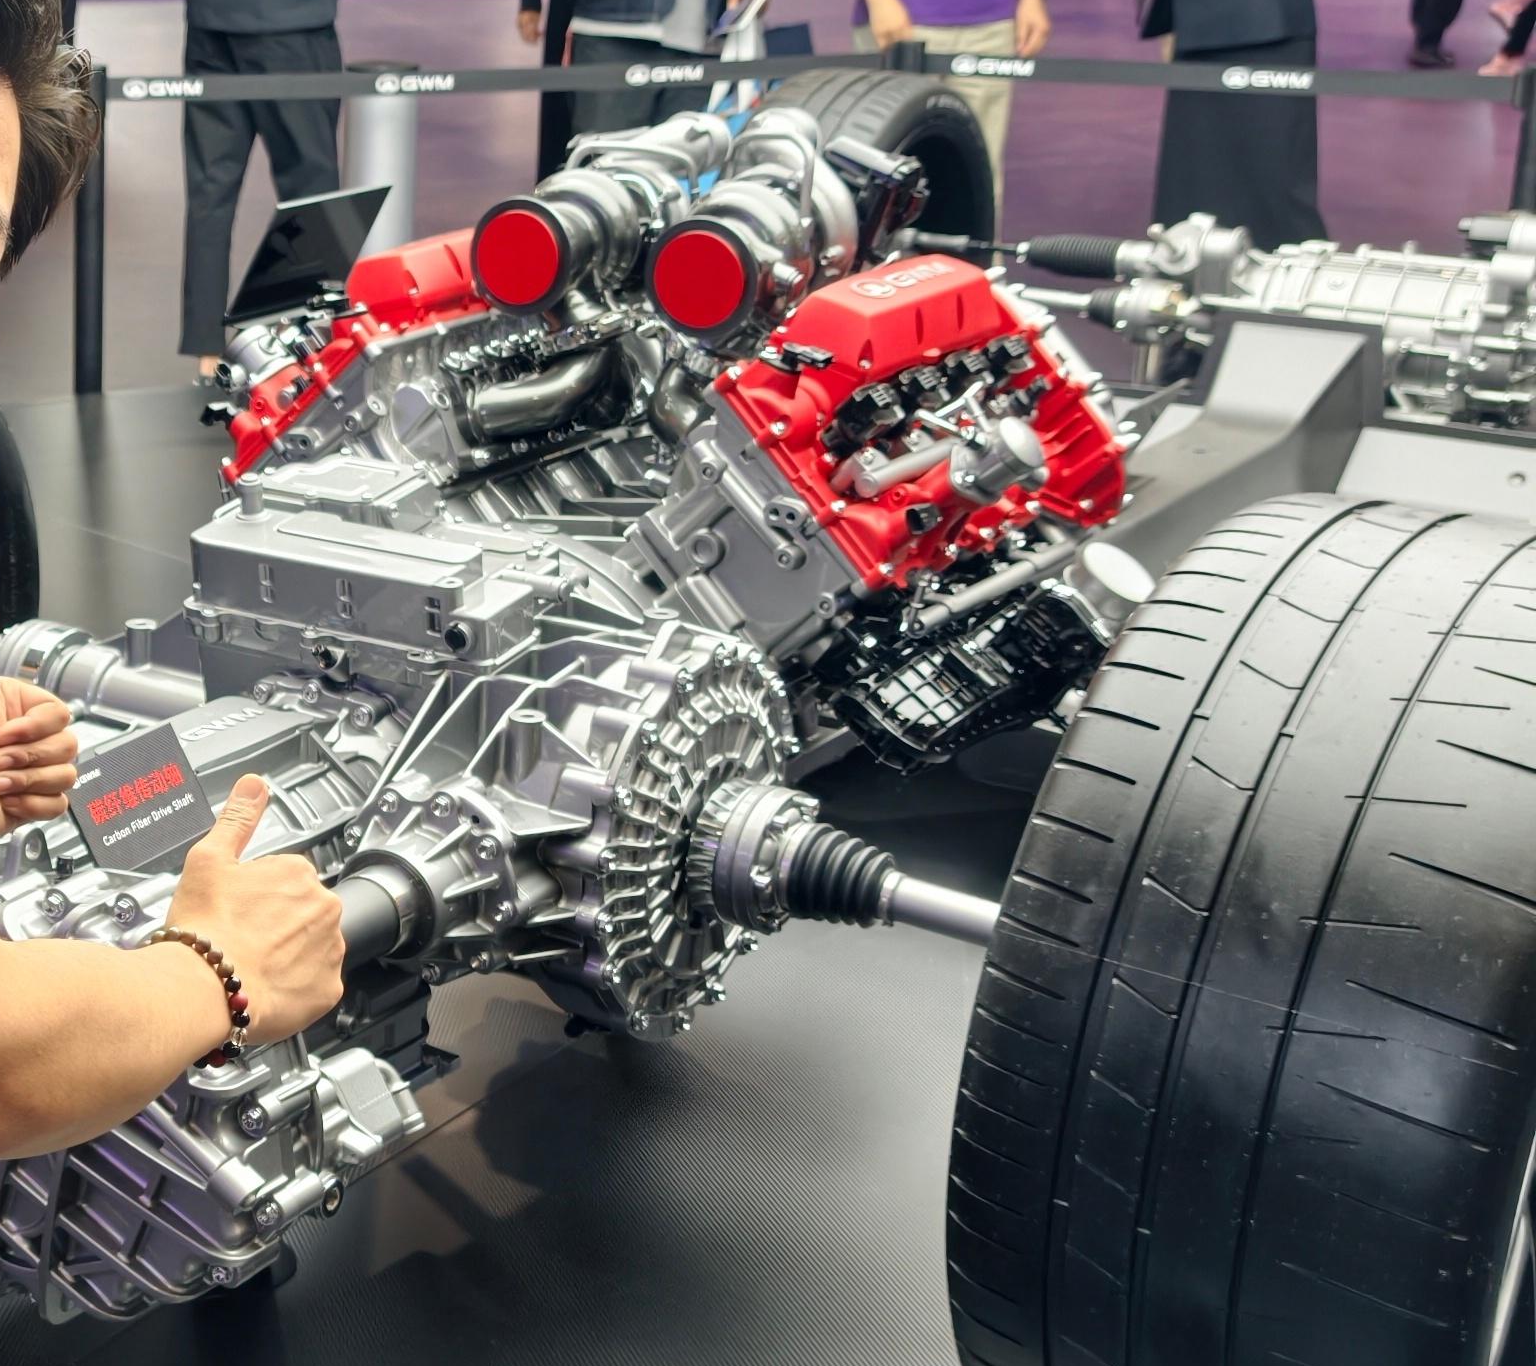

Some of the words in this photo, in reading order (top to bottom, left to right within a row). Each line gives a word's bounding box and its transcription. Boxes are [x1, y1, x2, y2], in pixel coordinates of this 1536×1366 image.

[651, 64, 705, 83] GWM
[977, 58, 1036, 77] GWM
[148, 78, 204, 97] GWM
[400, 74, 455, 92] GWM
[1250, 70, 1315, 90] GWM
[178, 707, 264, 742] GWM
[102, 826, 131, 846] Carbon
[130, 815, 152, 833] Fiber
[150, 806, 173, 822] Drive
[171, 793, 195, 811] Shaft
